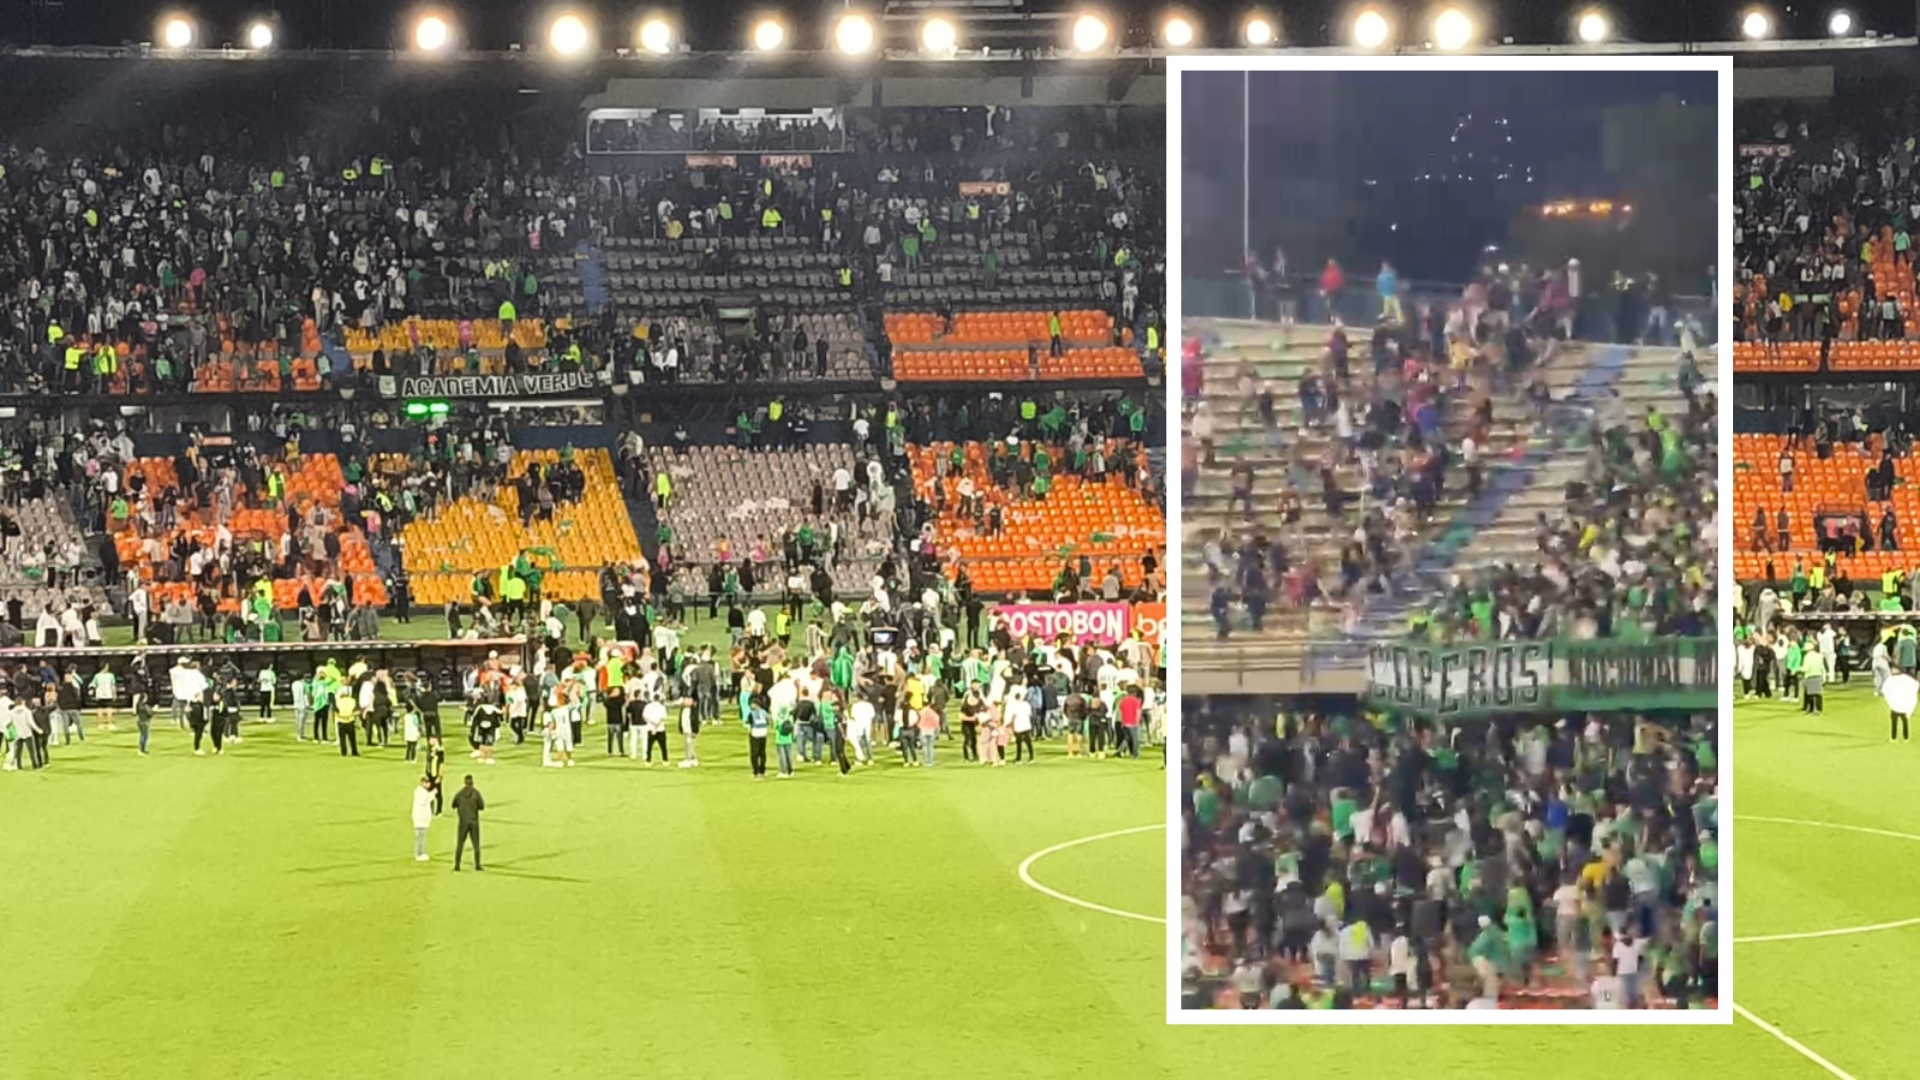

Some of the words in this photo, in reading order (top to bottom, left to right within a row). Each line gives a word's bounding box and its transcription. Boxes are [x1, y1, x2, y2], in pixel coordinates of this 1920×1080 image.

[402, 375, 519, 397] ACADEMIA
[523, 372, 593, 394] VERDE
[1001, 609, 1124, 640] OSTOBON
[1370, 645, 1541, 711] COPEROS
